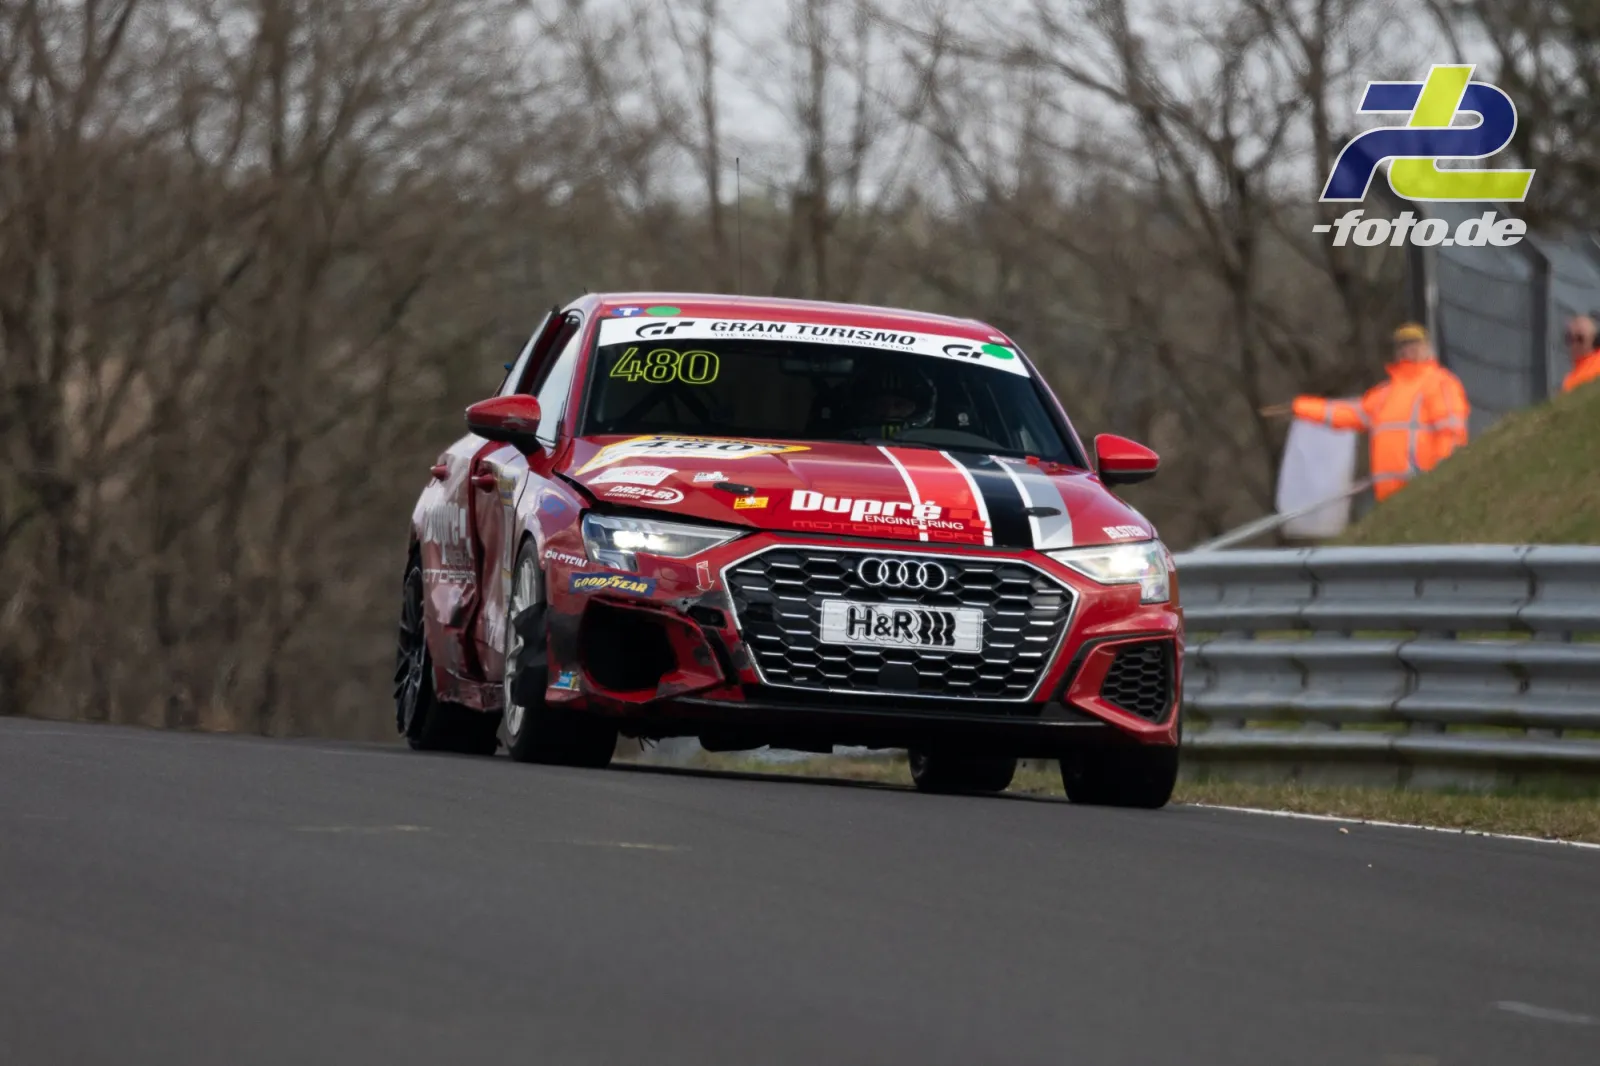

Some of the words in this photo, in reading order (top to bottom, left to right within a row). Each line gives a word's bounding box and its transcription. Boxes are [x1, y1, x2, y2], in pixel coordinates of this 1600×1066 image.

[710, 321, 786, 333] GRAN
[797, 324, 916, 346] TURISMO
[609, 347, 720, 385] 480
[630, 440, 755, 451] 480
[609, 485, 675, 500] DREXLER
[789, 489, 942, 522] Dupré
[864, 515, 965, 530] ENGINEERING
[573, 575, 649, 593] GOODYEAR
[848, 606, 915, 641] H&R
